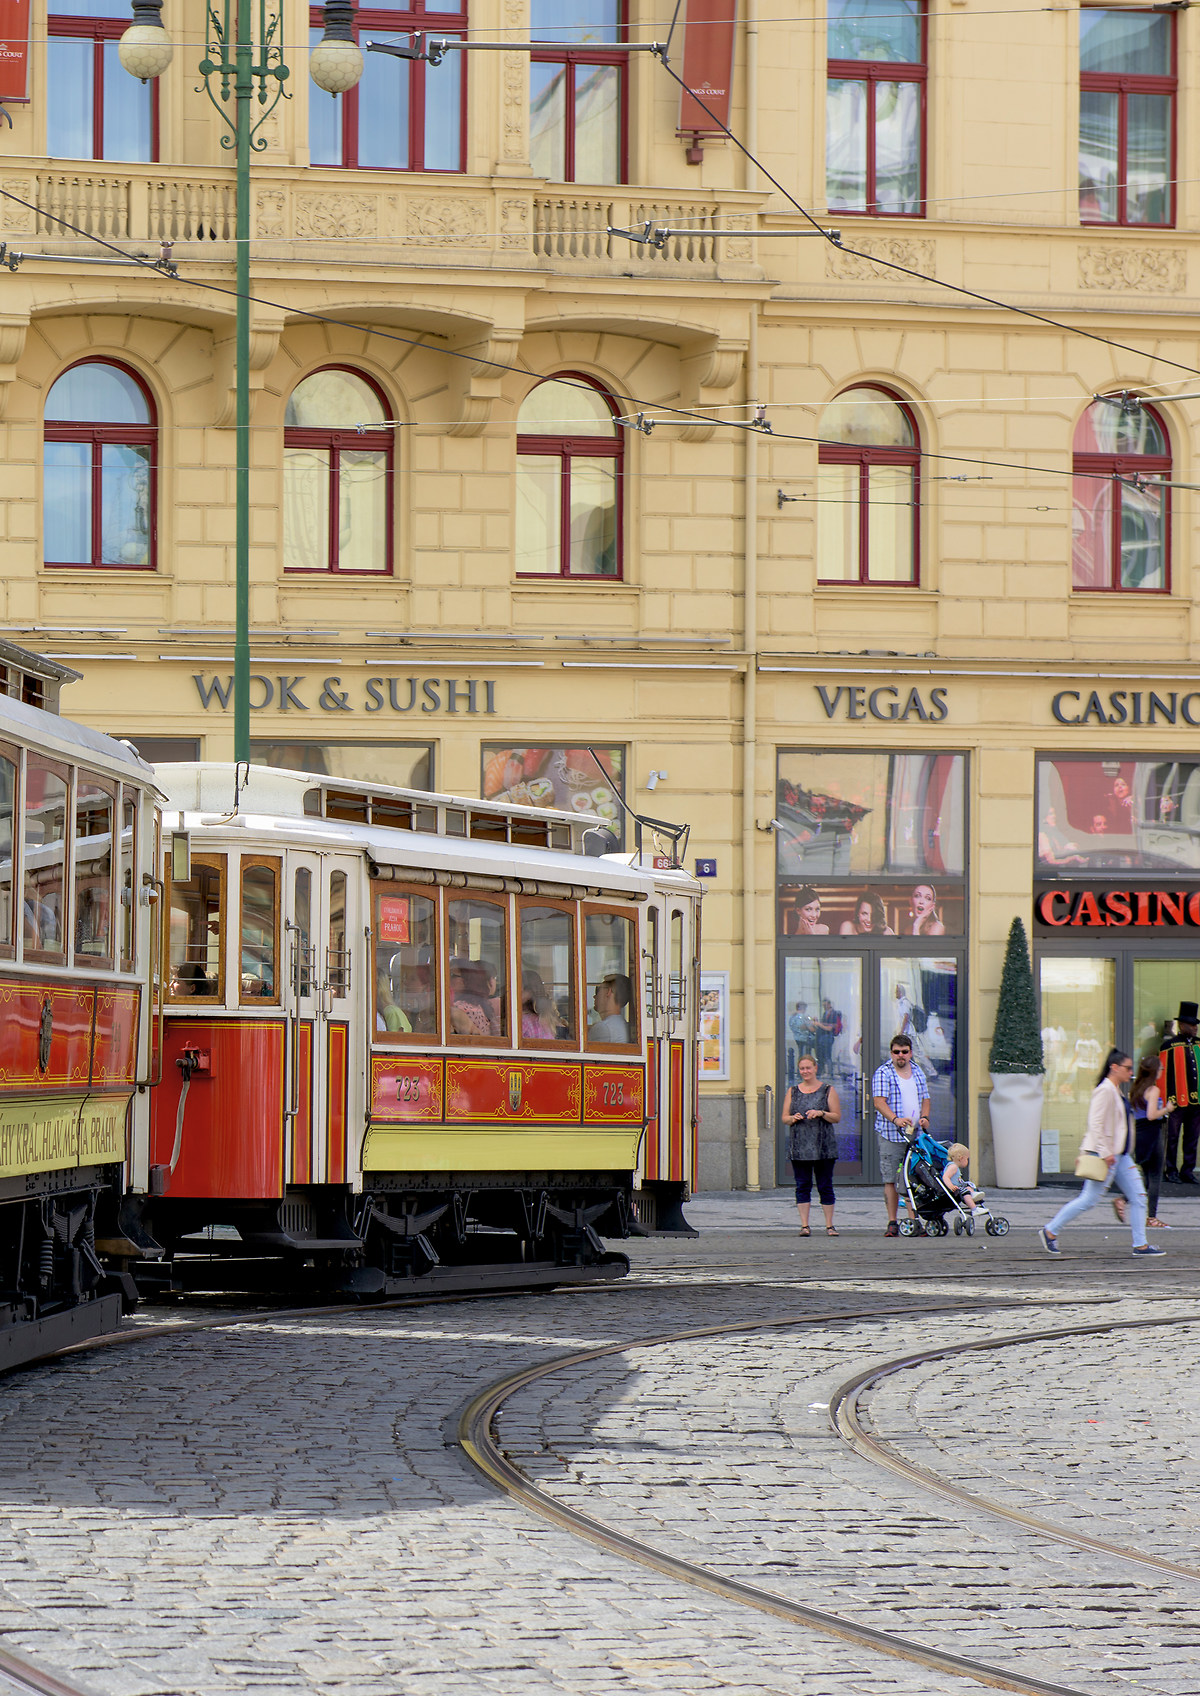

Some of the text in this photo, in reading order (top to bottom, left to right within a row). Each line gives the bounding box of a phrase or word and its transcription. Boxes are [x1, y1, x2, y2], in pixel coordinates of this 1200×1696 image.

[192, 675, 499, 713] WOK & SUSHI
[813, 685, 949, 721] VEGAS
[703, 863, 710, 873] 6
[395, 1076, 420, 1101] 723
[603, 1082, 624, 1105] 723
